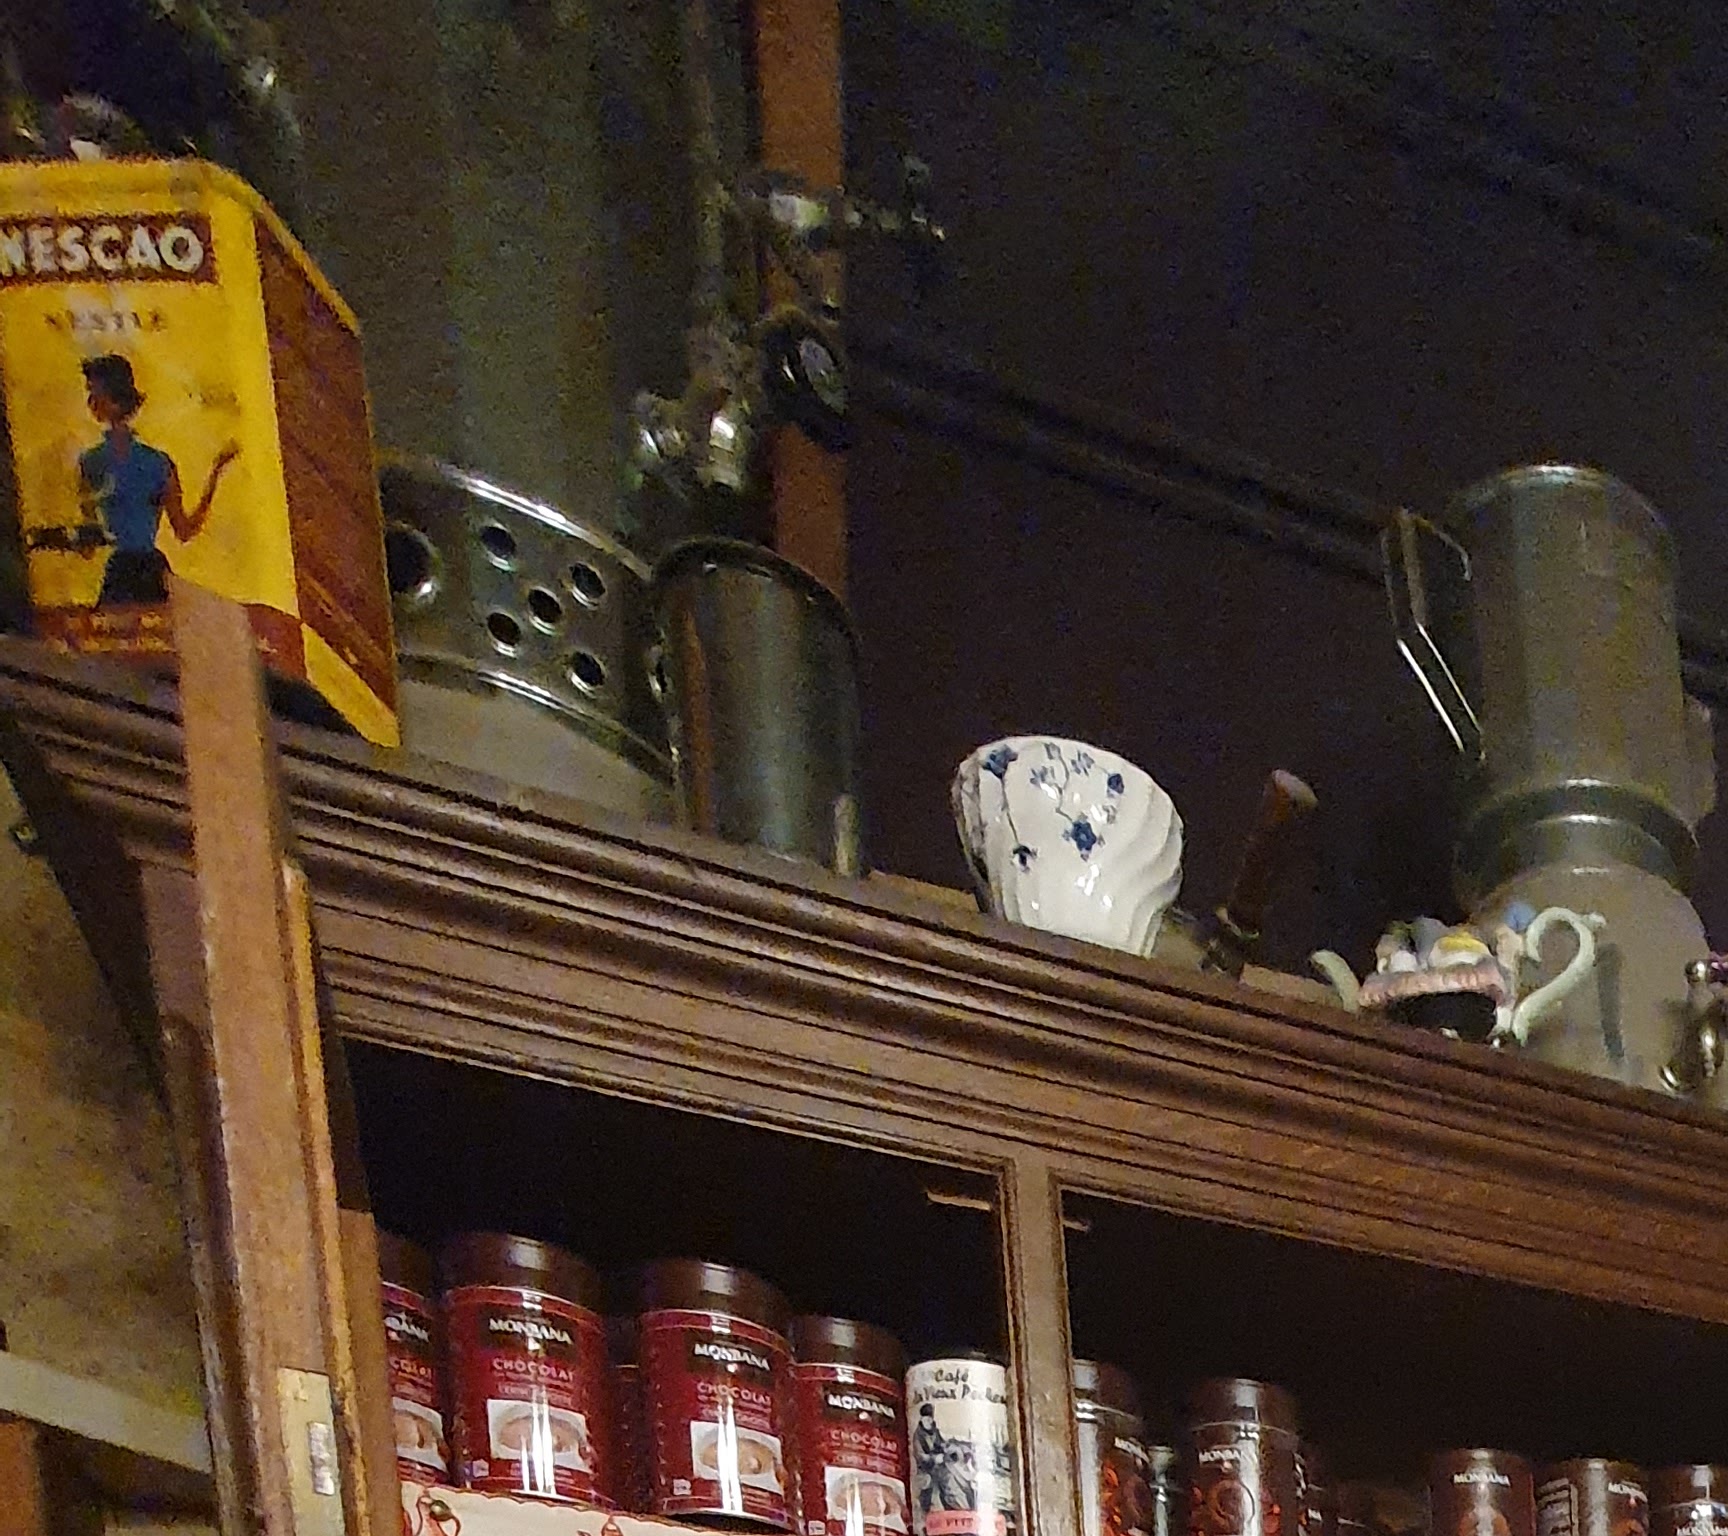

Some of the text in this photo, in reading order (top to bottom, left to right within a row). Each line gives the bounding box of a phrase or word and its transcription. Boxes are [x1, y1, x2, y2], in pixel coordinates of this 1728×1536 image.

[0, 224, 204, 276] NESCAO
[488, 1317, 574, 1346] MONBANA
[492, 1356, 575, 1382] CHOCOLAT
[694, 1342, 771, 1371] MONBANA
[696, 1380, 773, 1405] CHOCOLAT
[827, 1392, 896, 1420] MONBANA
[830, 1428, 899, 1451] CHOCOLAT
